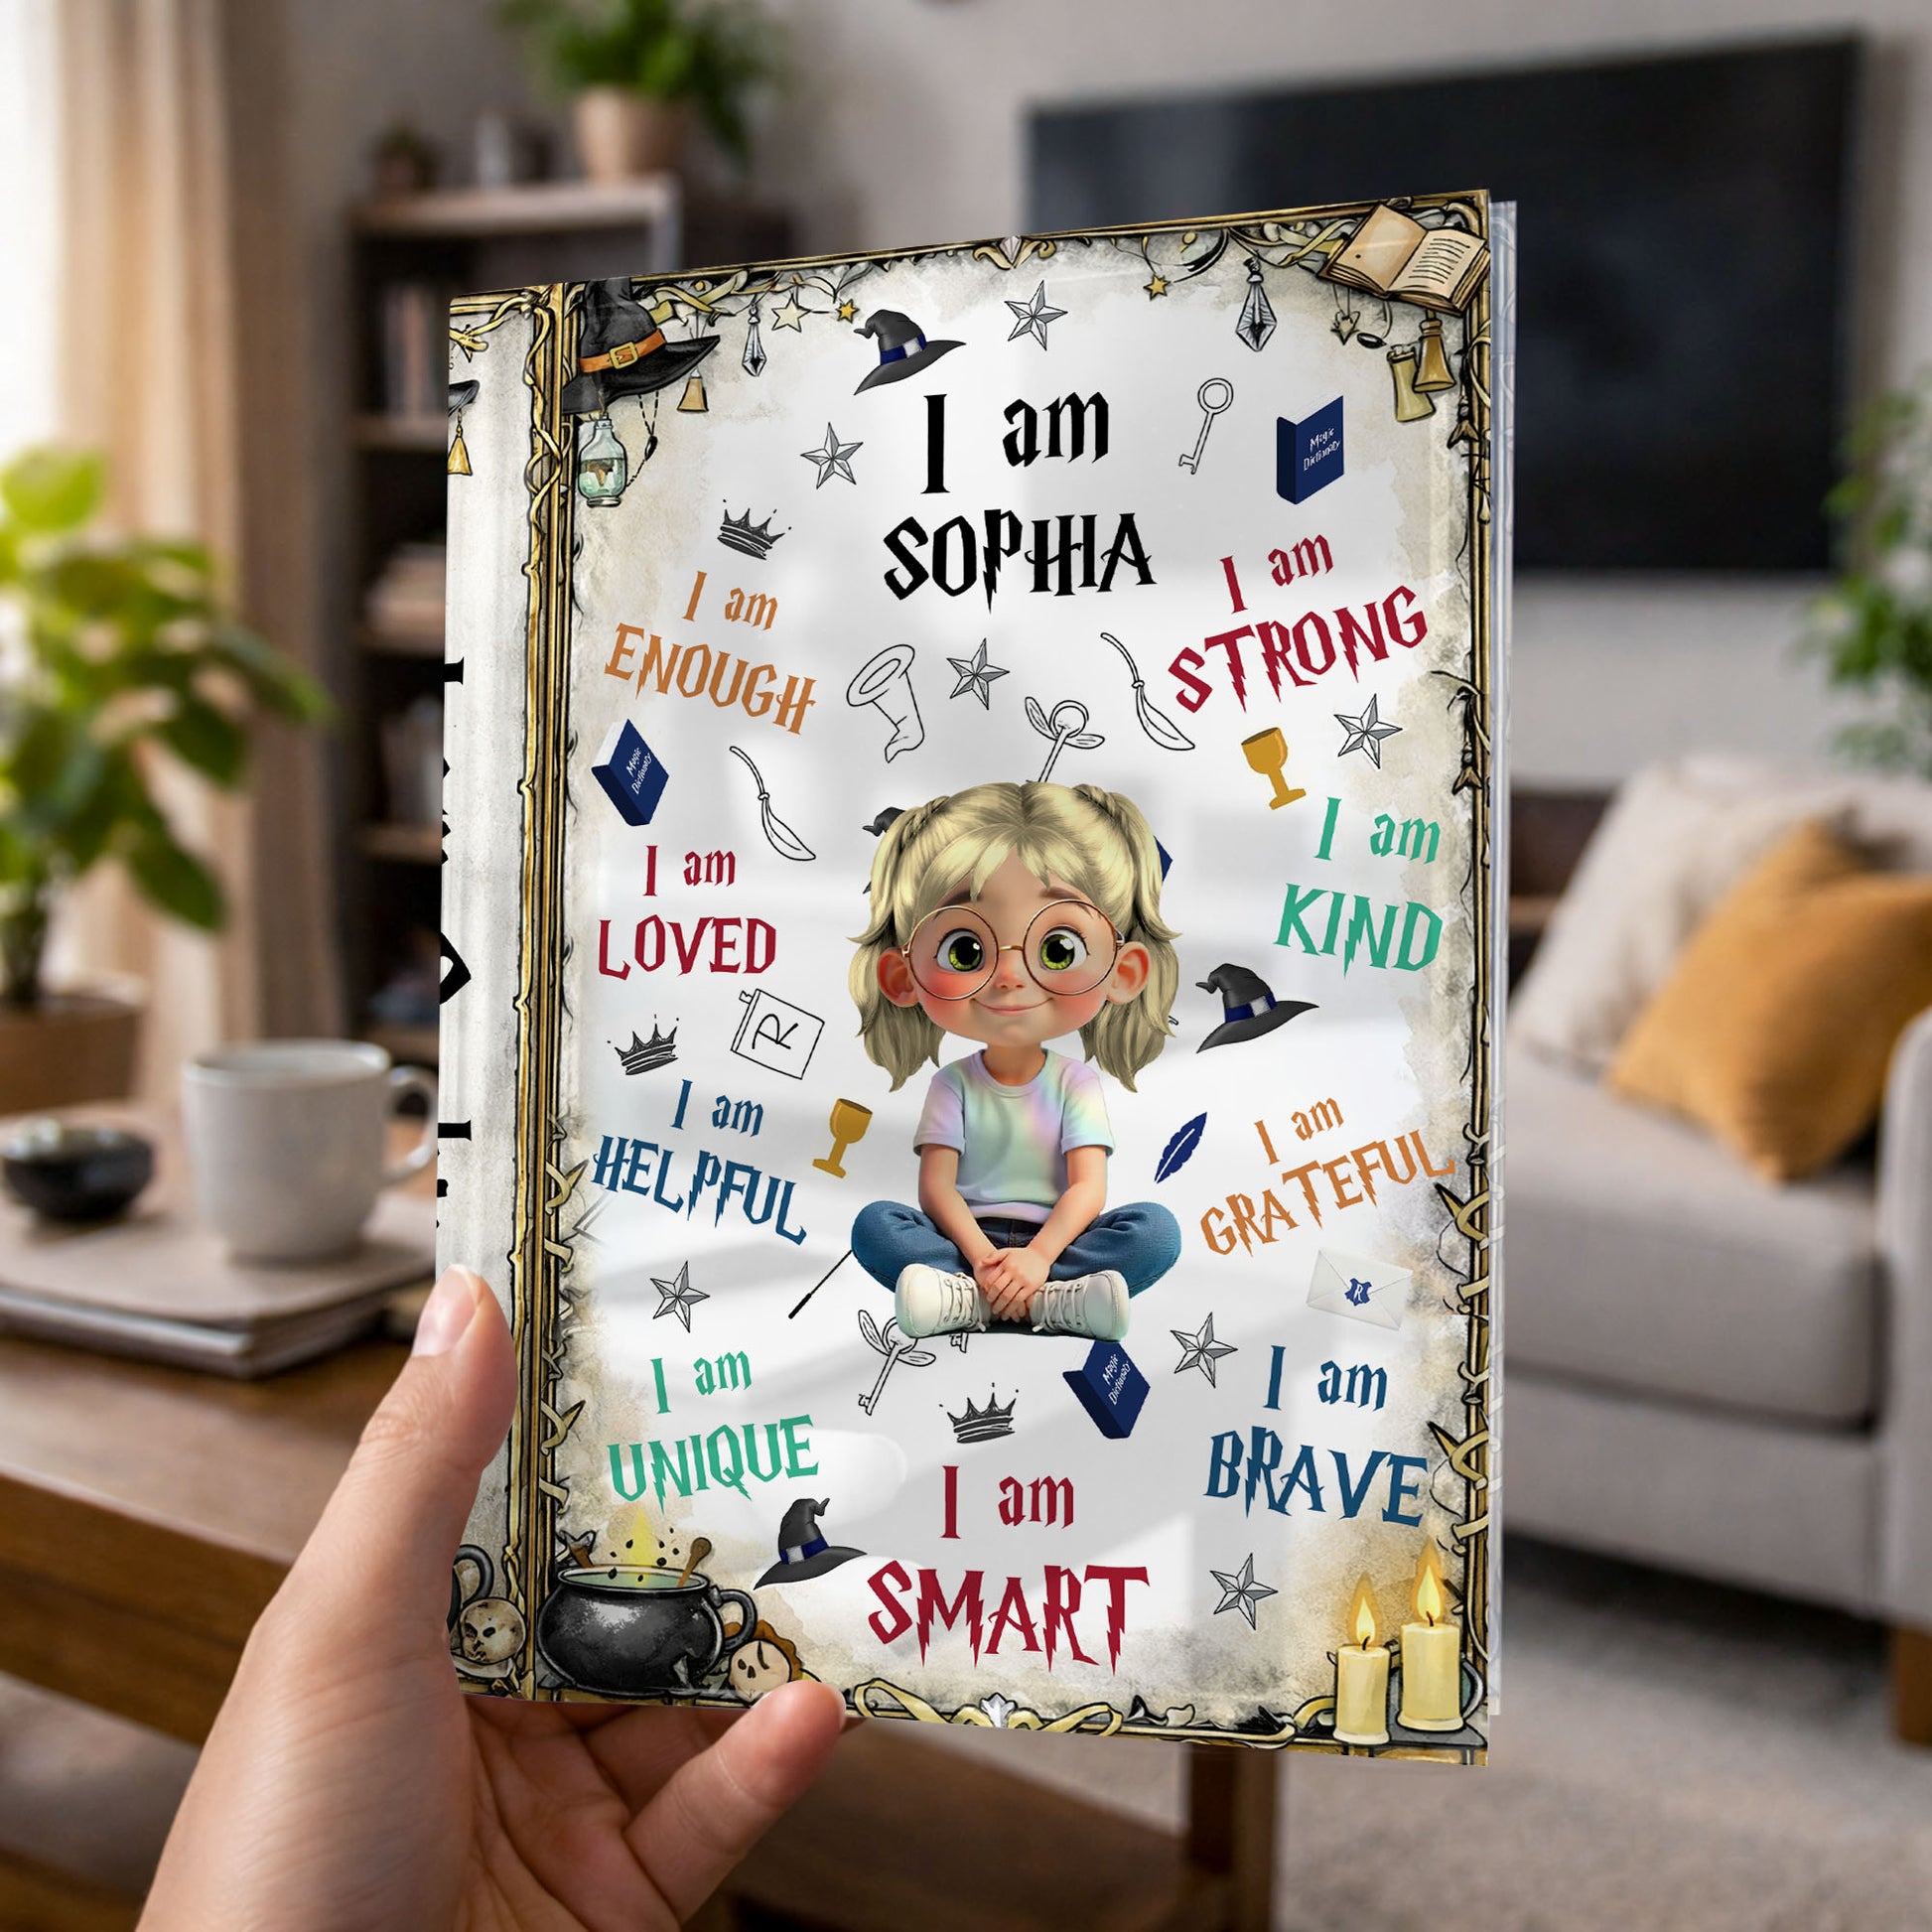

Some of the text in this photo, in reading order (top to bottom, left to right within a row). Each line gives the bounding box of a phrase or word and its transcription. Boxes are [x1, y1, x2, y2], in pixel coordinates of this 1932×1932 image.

[919, 391, 1109, 494] I am
[682, 571, 777, 629] I am
[883, 508, 1158, 614] SOPHIA
[1219, 534, 1333, 614] I am
[604, 621, 817, 736] ENOUGH
[1168, 585, 1428, 714] STRONG
[642, 845, 736, 897] I am
[1314, 796, 1441, 863] I am
[599, 914, 776, 980] LOVED
[1273, 883, 1443, 977] KIND
[671, 1079, 763, 1137] I am
[1253, 1098, 1343, 1165] I am
[592, 1135, 807, 1245] HELPFUL
[1199, 1130, 1455, 1257] GRATEFUL
[650, 1351, 752, 1414] I am
[1263, 1345, 1387, 1410] I am
[608, 1415, 819, 1514] UNIQUE
[939, 1465, 1074, 1539] I am
[1203, 1426, 1428, 1527] BRAVE
[867, 1560, 1150, 1675] SMART
